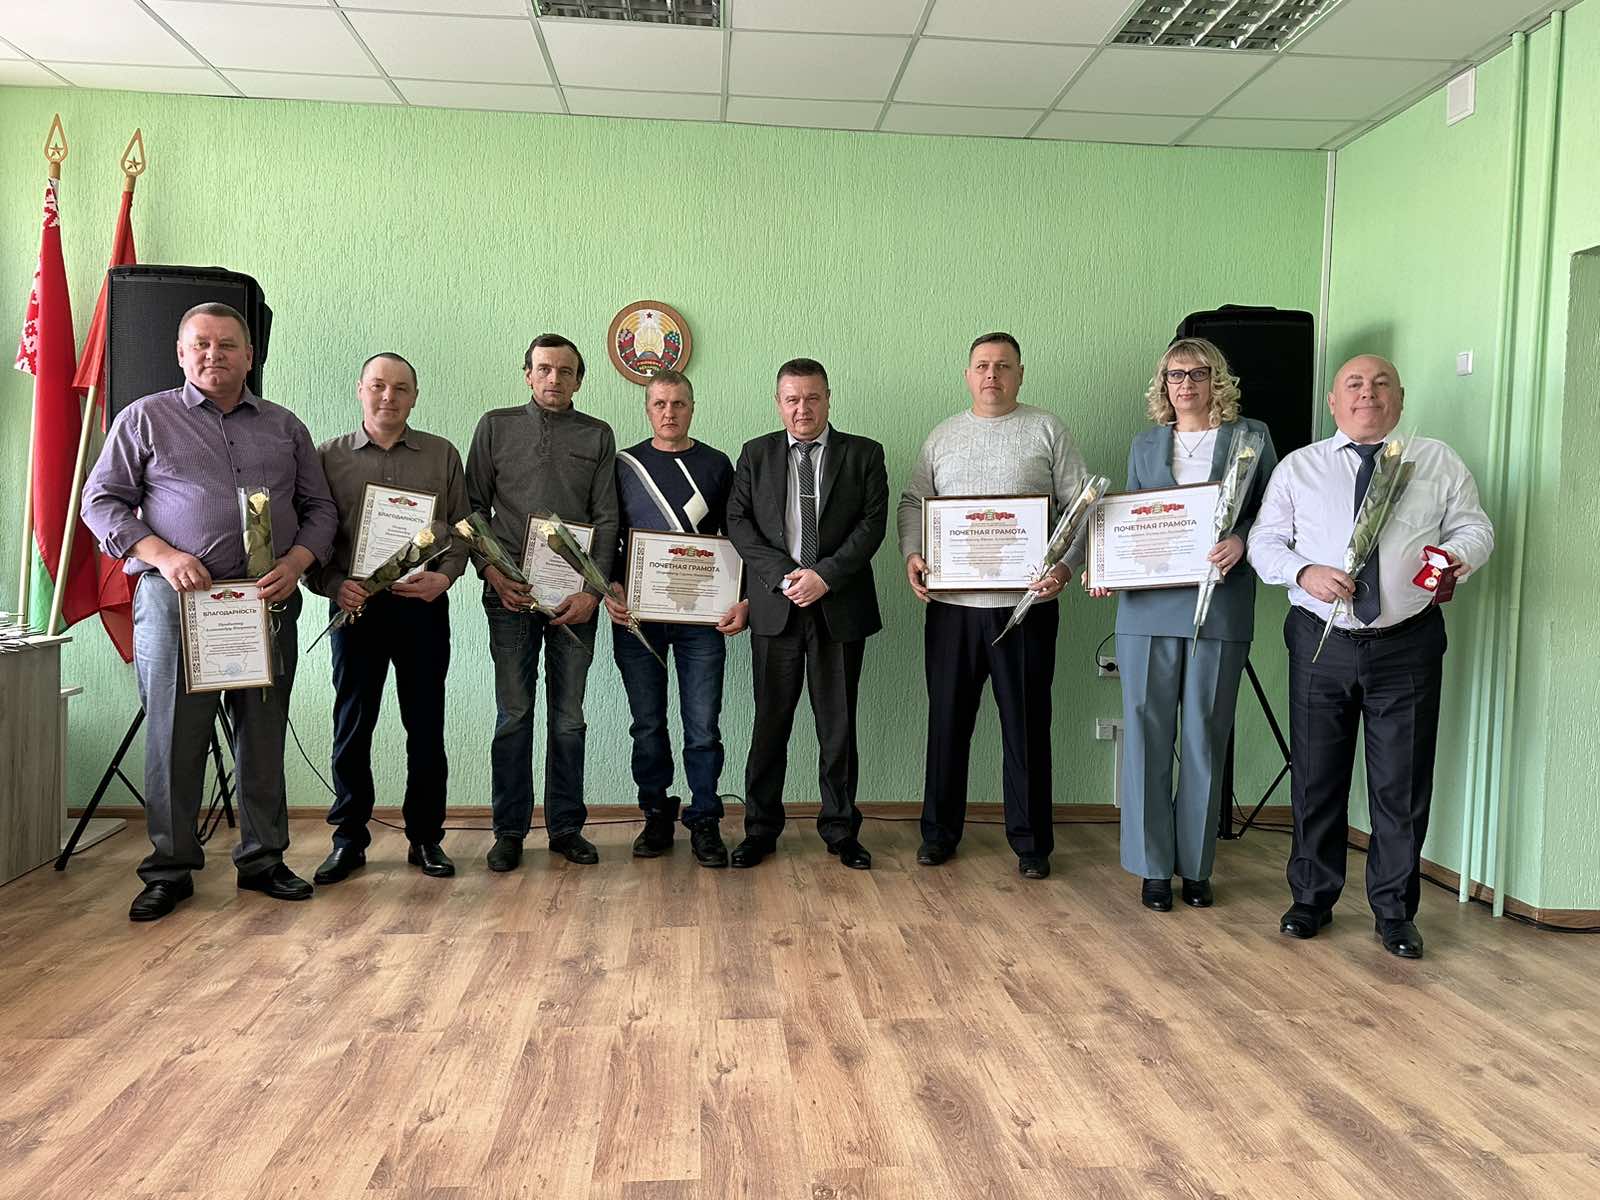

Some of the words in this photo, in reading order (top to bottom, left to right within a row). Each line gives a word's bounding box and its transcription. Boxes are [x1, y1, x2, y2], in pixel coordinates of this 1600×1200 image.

[378, 511, 424, 523] БЛАГОДАРНОСТЬ
[949, 528, 990, 536] ПОЧЕТНАЯ
[1114, 522, 1157, 533] ПОЧЕТНАЯ
[1158, 519, 1197, 528] ГРАМОТА
[649, 561, 687, 571] ПОЧЕТНАЯ
[688, 564, 720, 573] ГРАМОТА
[203, 608, 257, 617] БЛАГОДАРНОСТЬ
